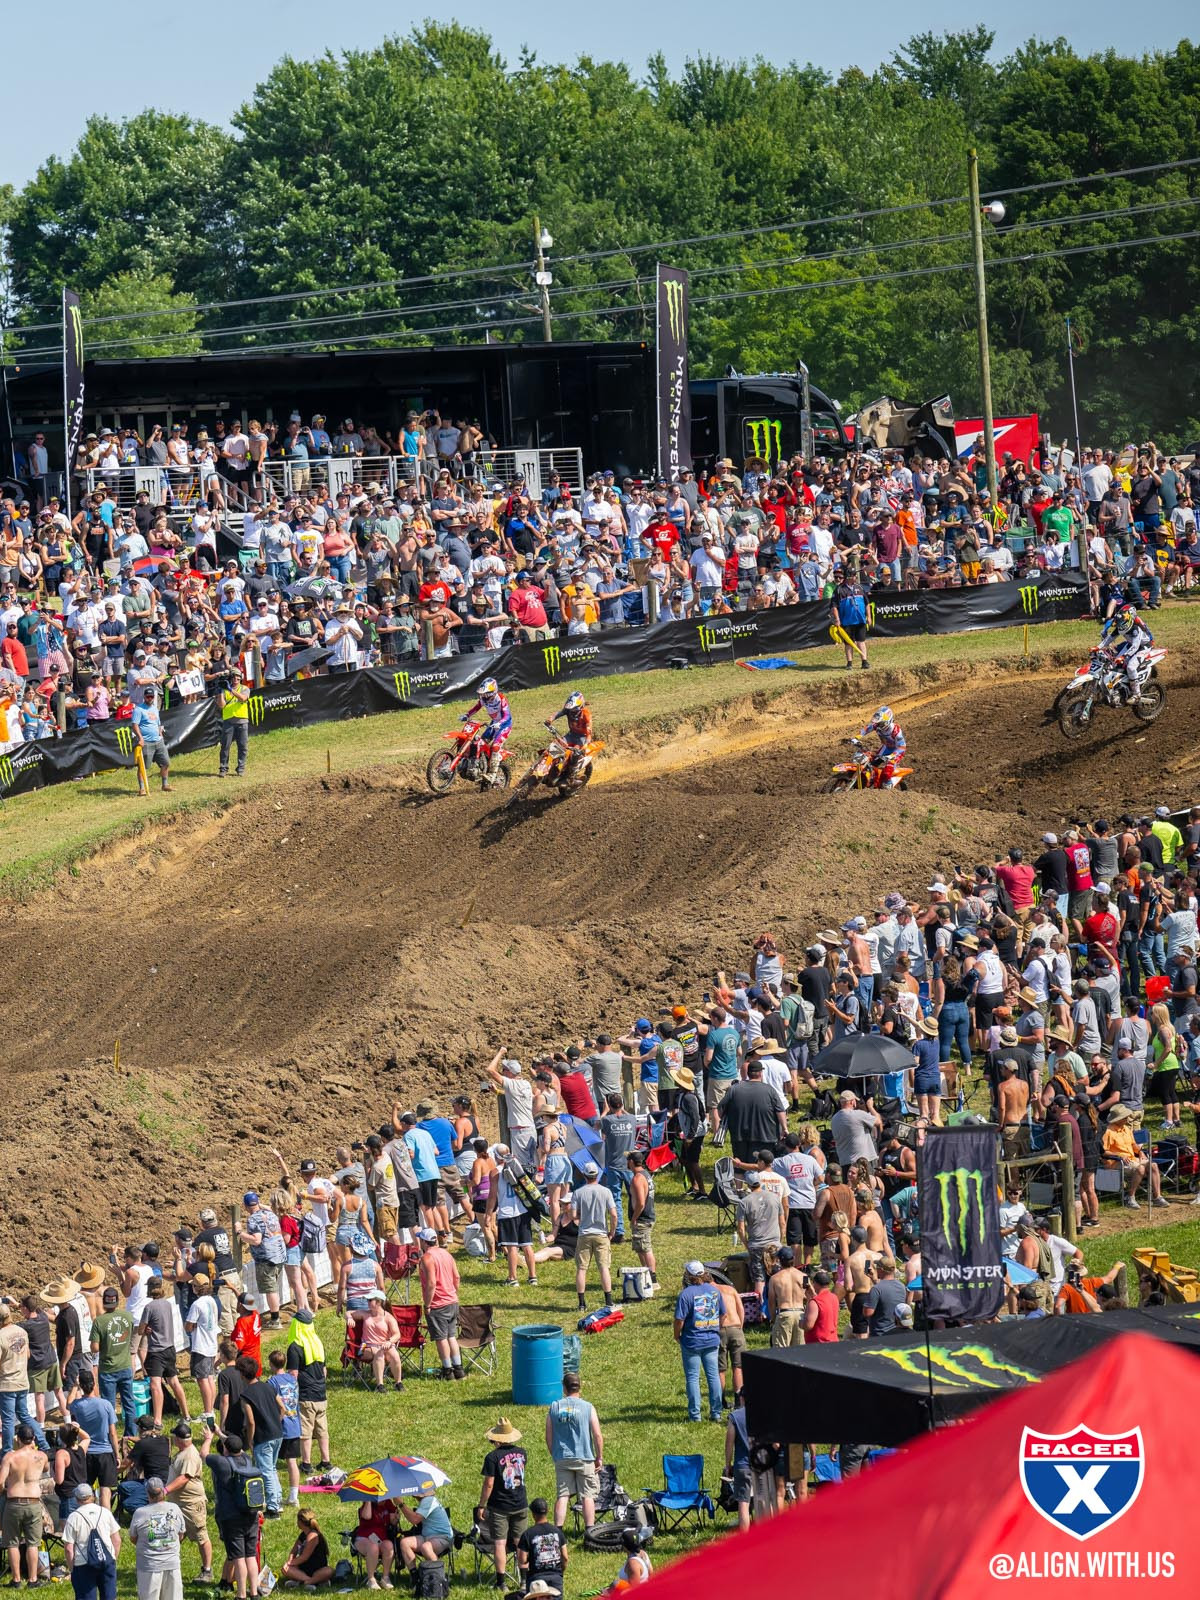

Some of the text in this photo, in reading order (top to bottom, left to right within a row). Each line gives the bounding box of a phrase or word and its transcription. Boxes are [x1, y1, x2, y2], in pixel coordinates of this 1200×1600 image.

[1039, 587, 1078, 597] MONSTER
[876, 603, 919, 615] MONSTER
[716, 623, 758, 636] MONSTER
[560, 646, 600, 659] MONSTER
[410, 671, 449, 684] MONSTER
[264, 694, 301, 708] MONSTER
[12, 753, 43, 768] MONSTER
[927, 1264, 1003, 1281] MONSTER
[937, 1282, 993, 1290] ENERGY
[401, 1486, 419, 1494] USA
